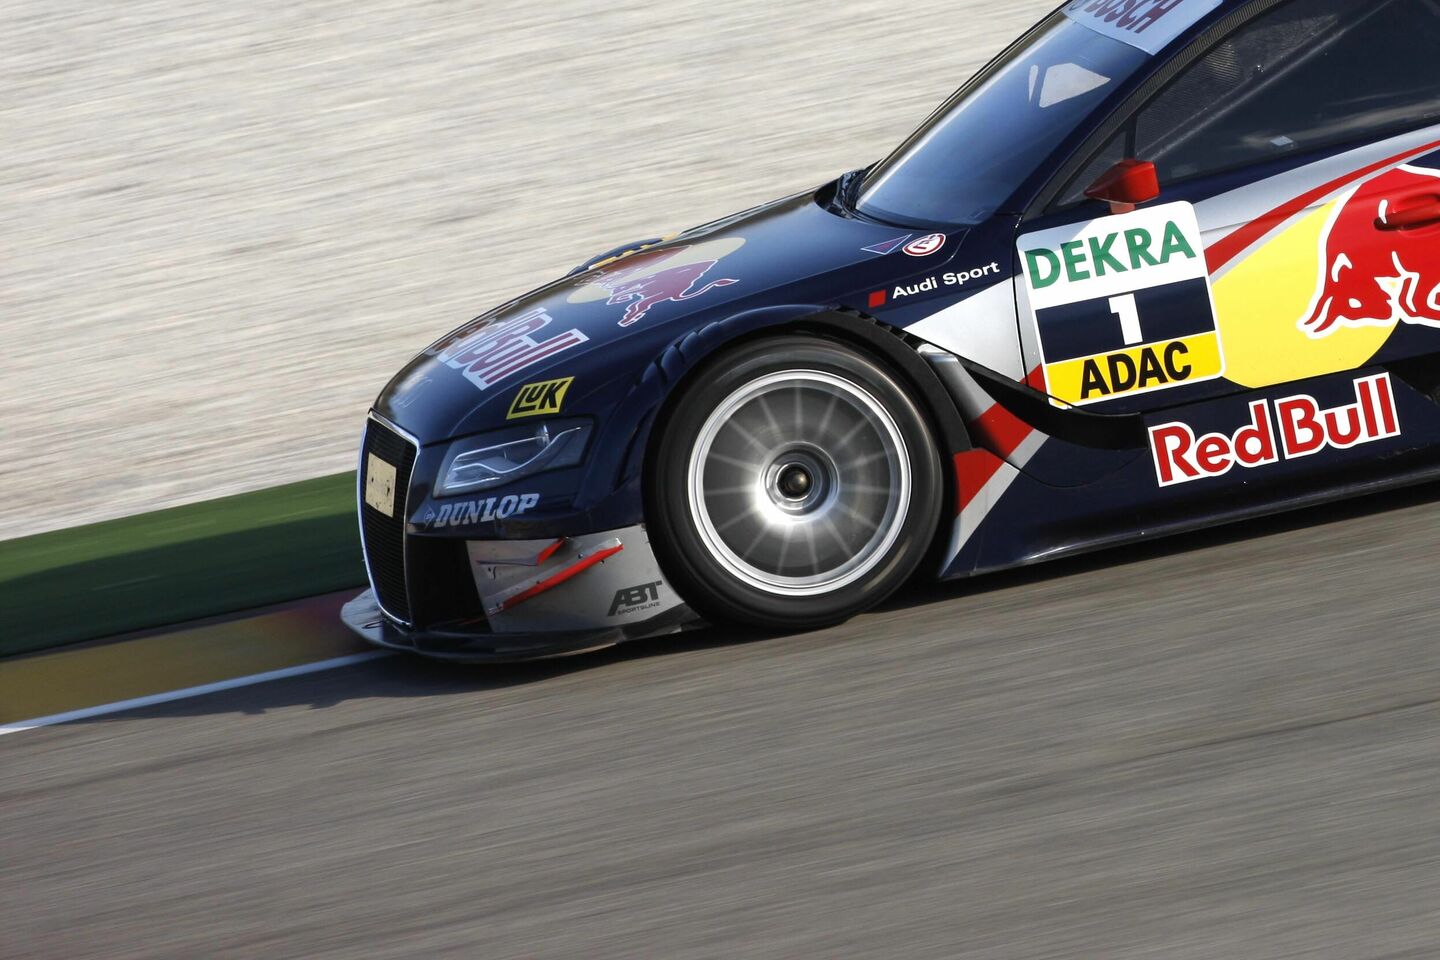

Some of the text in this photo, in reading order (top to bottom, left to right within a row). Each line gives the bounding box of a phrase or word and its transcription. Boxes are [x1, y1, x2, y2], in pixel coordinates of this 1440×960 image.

[893, 261, 1000, 299] Audi Sport
[1024, 220, 1197, 290] DEKRA
[1108, 293, 1143, 345] 1
[1080, 341, 1192, 400] ADAC
[1150, 374, 1400, 486] Red Bull
[433, 493, 540, 528] DUNLOP
[607, 580, 662, 617] ABT
